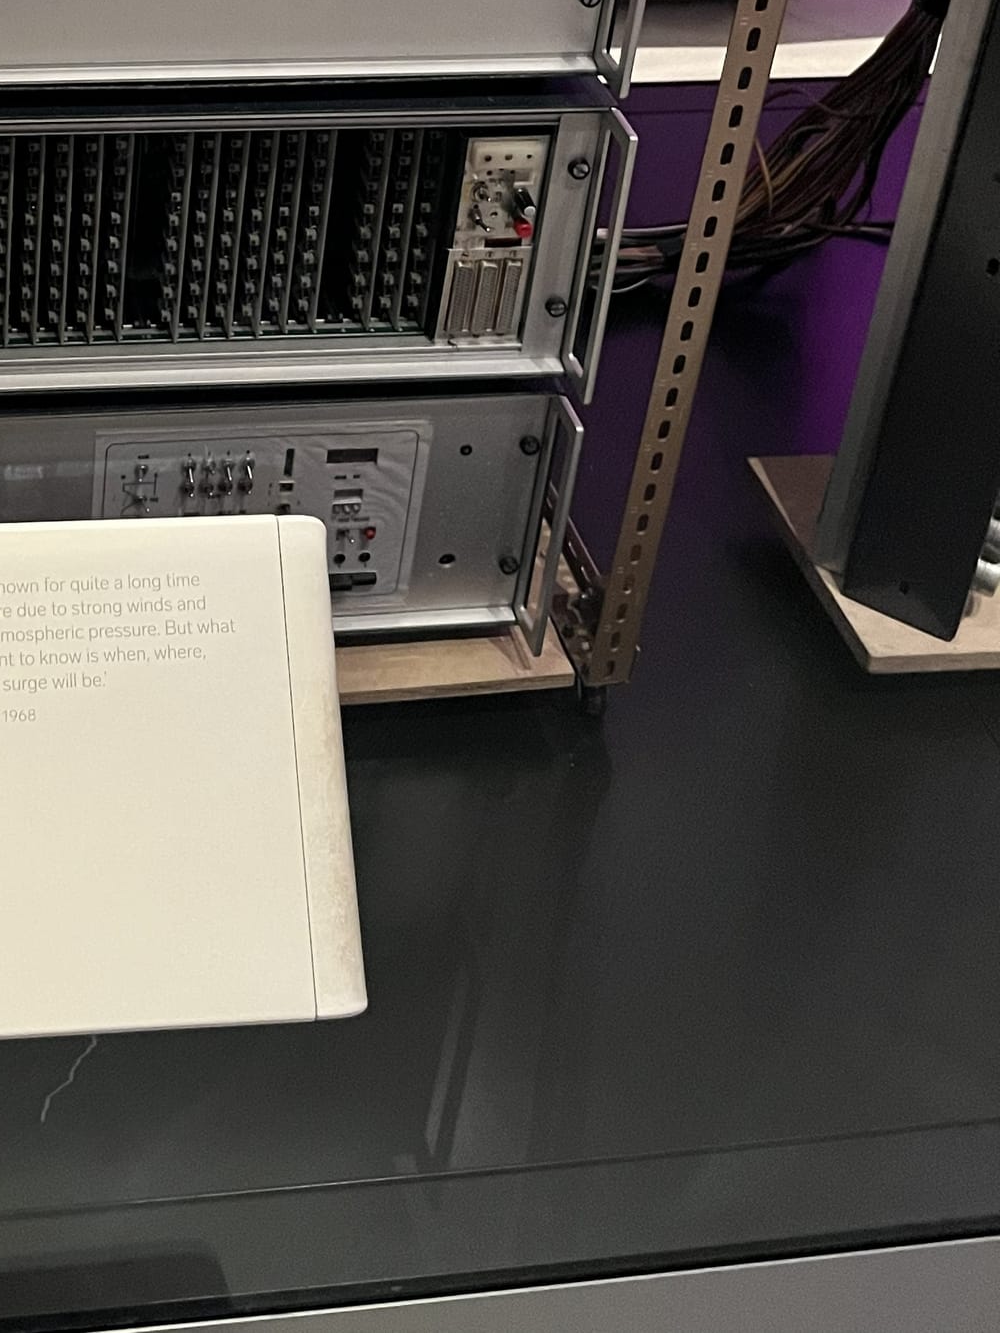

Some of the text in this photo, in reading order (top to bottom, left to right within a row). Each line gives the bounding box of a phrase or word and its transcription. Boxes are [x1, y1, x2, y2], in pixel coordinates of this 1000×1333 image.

[44, 576, 67, 593] for
[69, 575, 110, 595] quite
[113, 577, 124, 591] a
[127, 573, 162, 593] long
[165, 572, 201, 589] time
[16, 601, 47, 619] due
[51, 601, 68, 617] to
[71, 599, 123, 618] strong
[126, 594, 174, 614] winds
[176, 594, 207, 613] and
[88, 623, 161, 643] pressure.
[164, 618, 194, 637] But
[196, 617, 236, 635] what
[19, 651, 36, 667] to
[39, 649, 83, 667] know
[85, 646, 100, 664] is
[103, 645, 151, 664] when,
[153, 643, 207, 661] where,
[2, 676, 48, 695] surge
[51, 671, 77, 690] will
[1, 707, 37, 723] 1968
